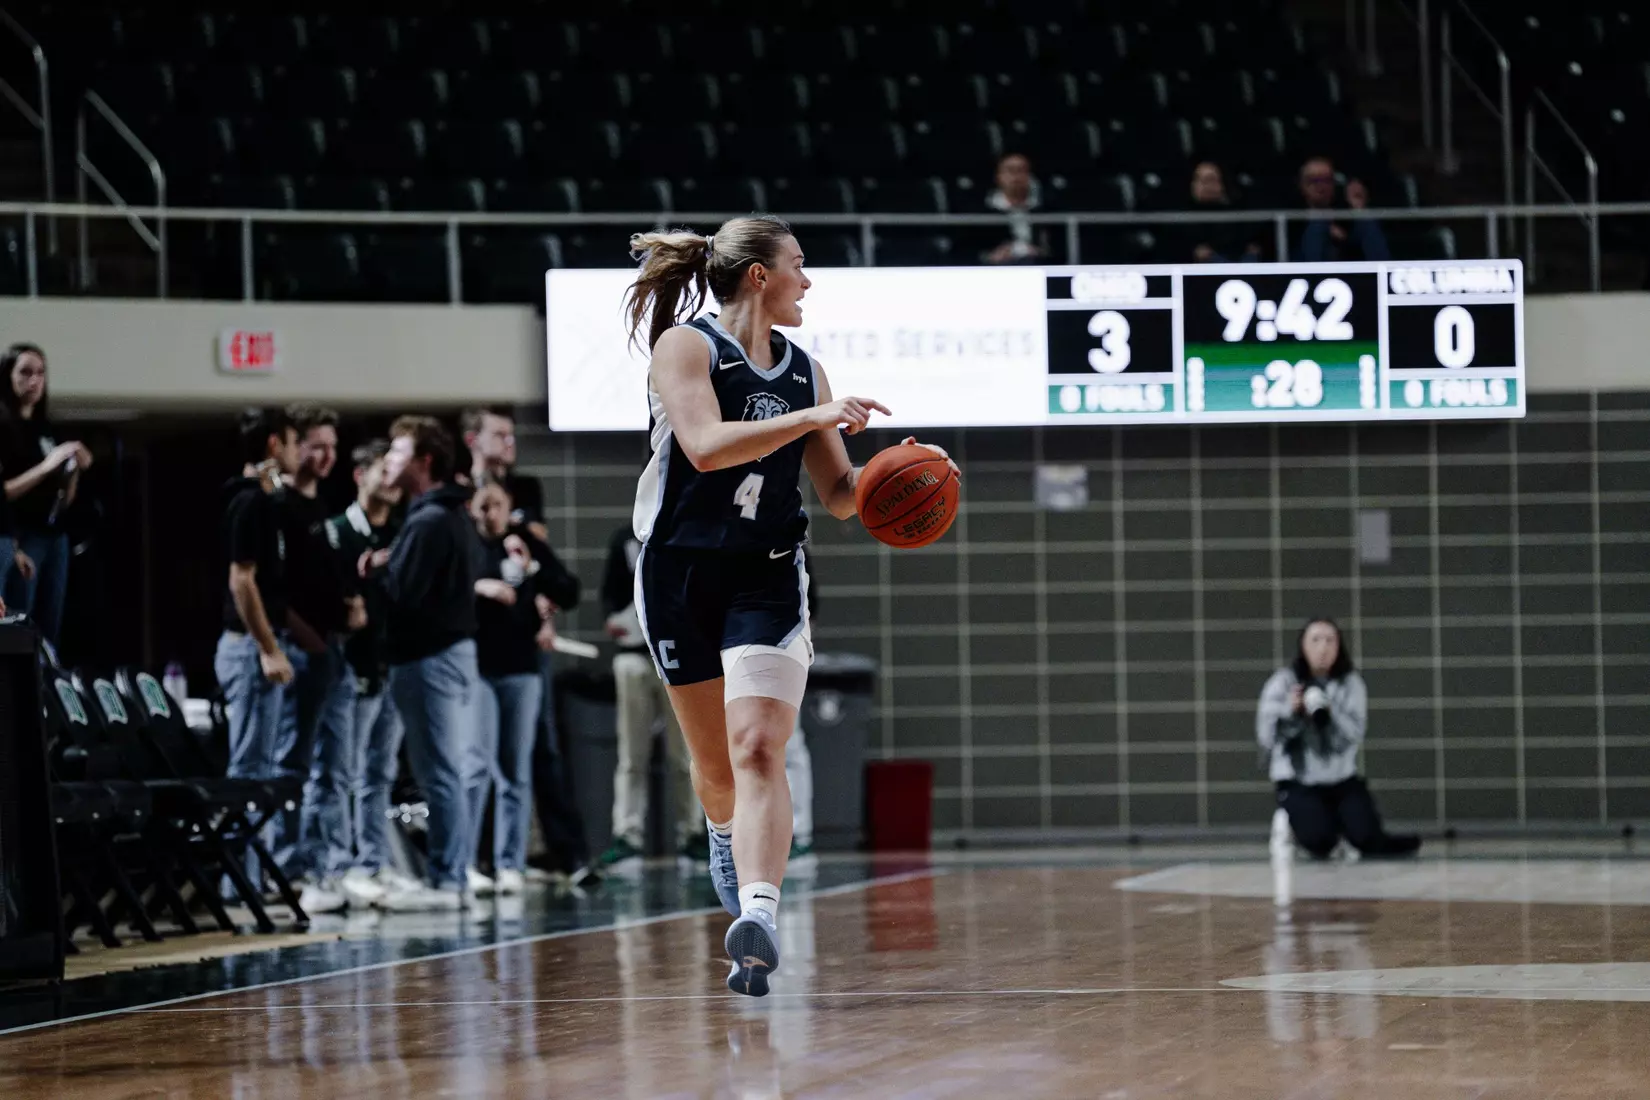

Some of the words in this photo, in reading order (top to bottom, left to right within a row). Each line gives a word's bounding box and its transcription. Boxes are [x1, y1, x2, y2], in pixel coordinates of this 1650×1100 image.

[1217, 279, 1352, 341] 9:42
[1089, 311, 1131, 374] 3
[1435, 306, 1475, 369] 0
[733, 473, 764, 520] 4
[876, 468, 939, 519] SPALDING
[893, 496, 946, 536] LEGACY
[658, 640, 680, 669] C
